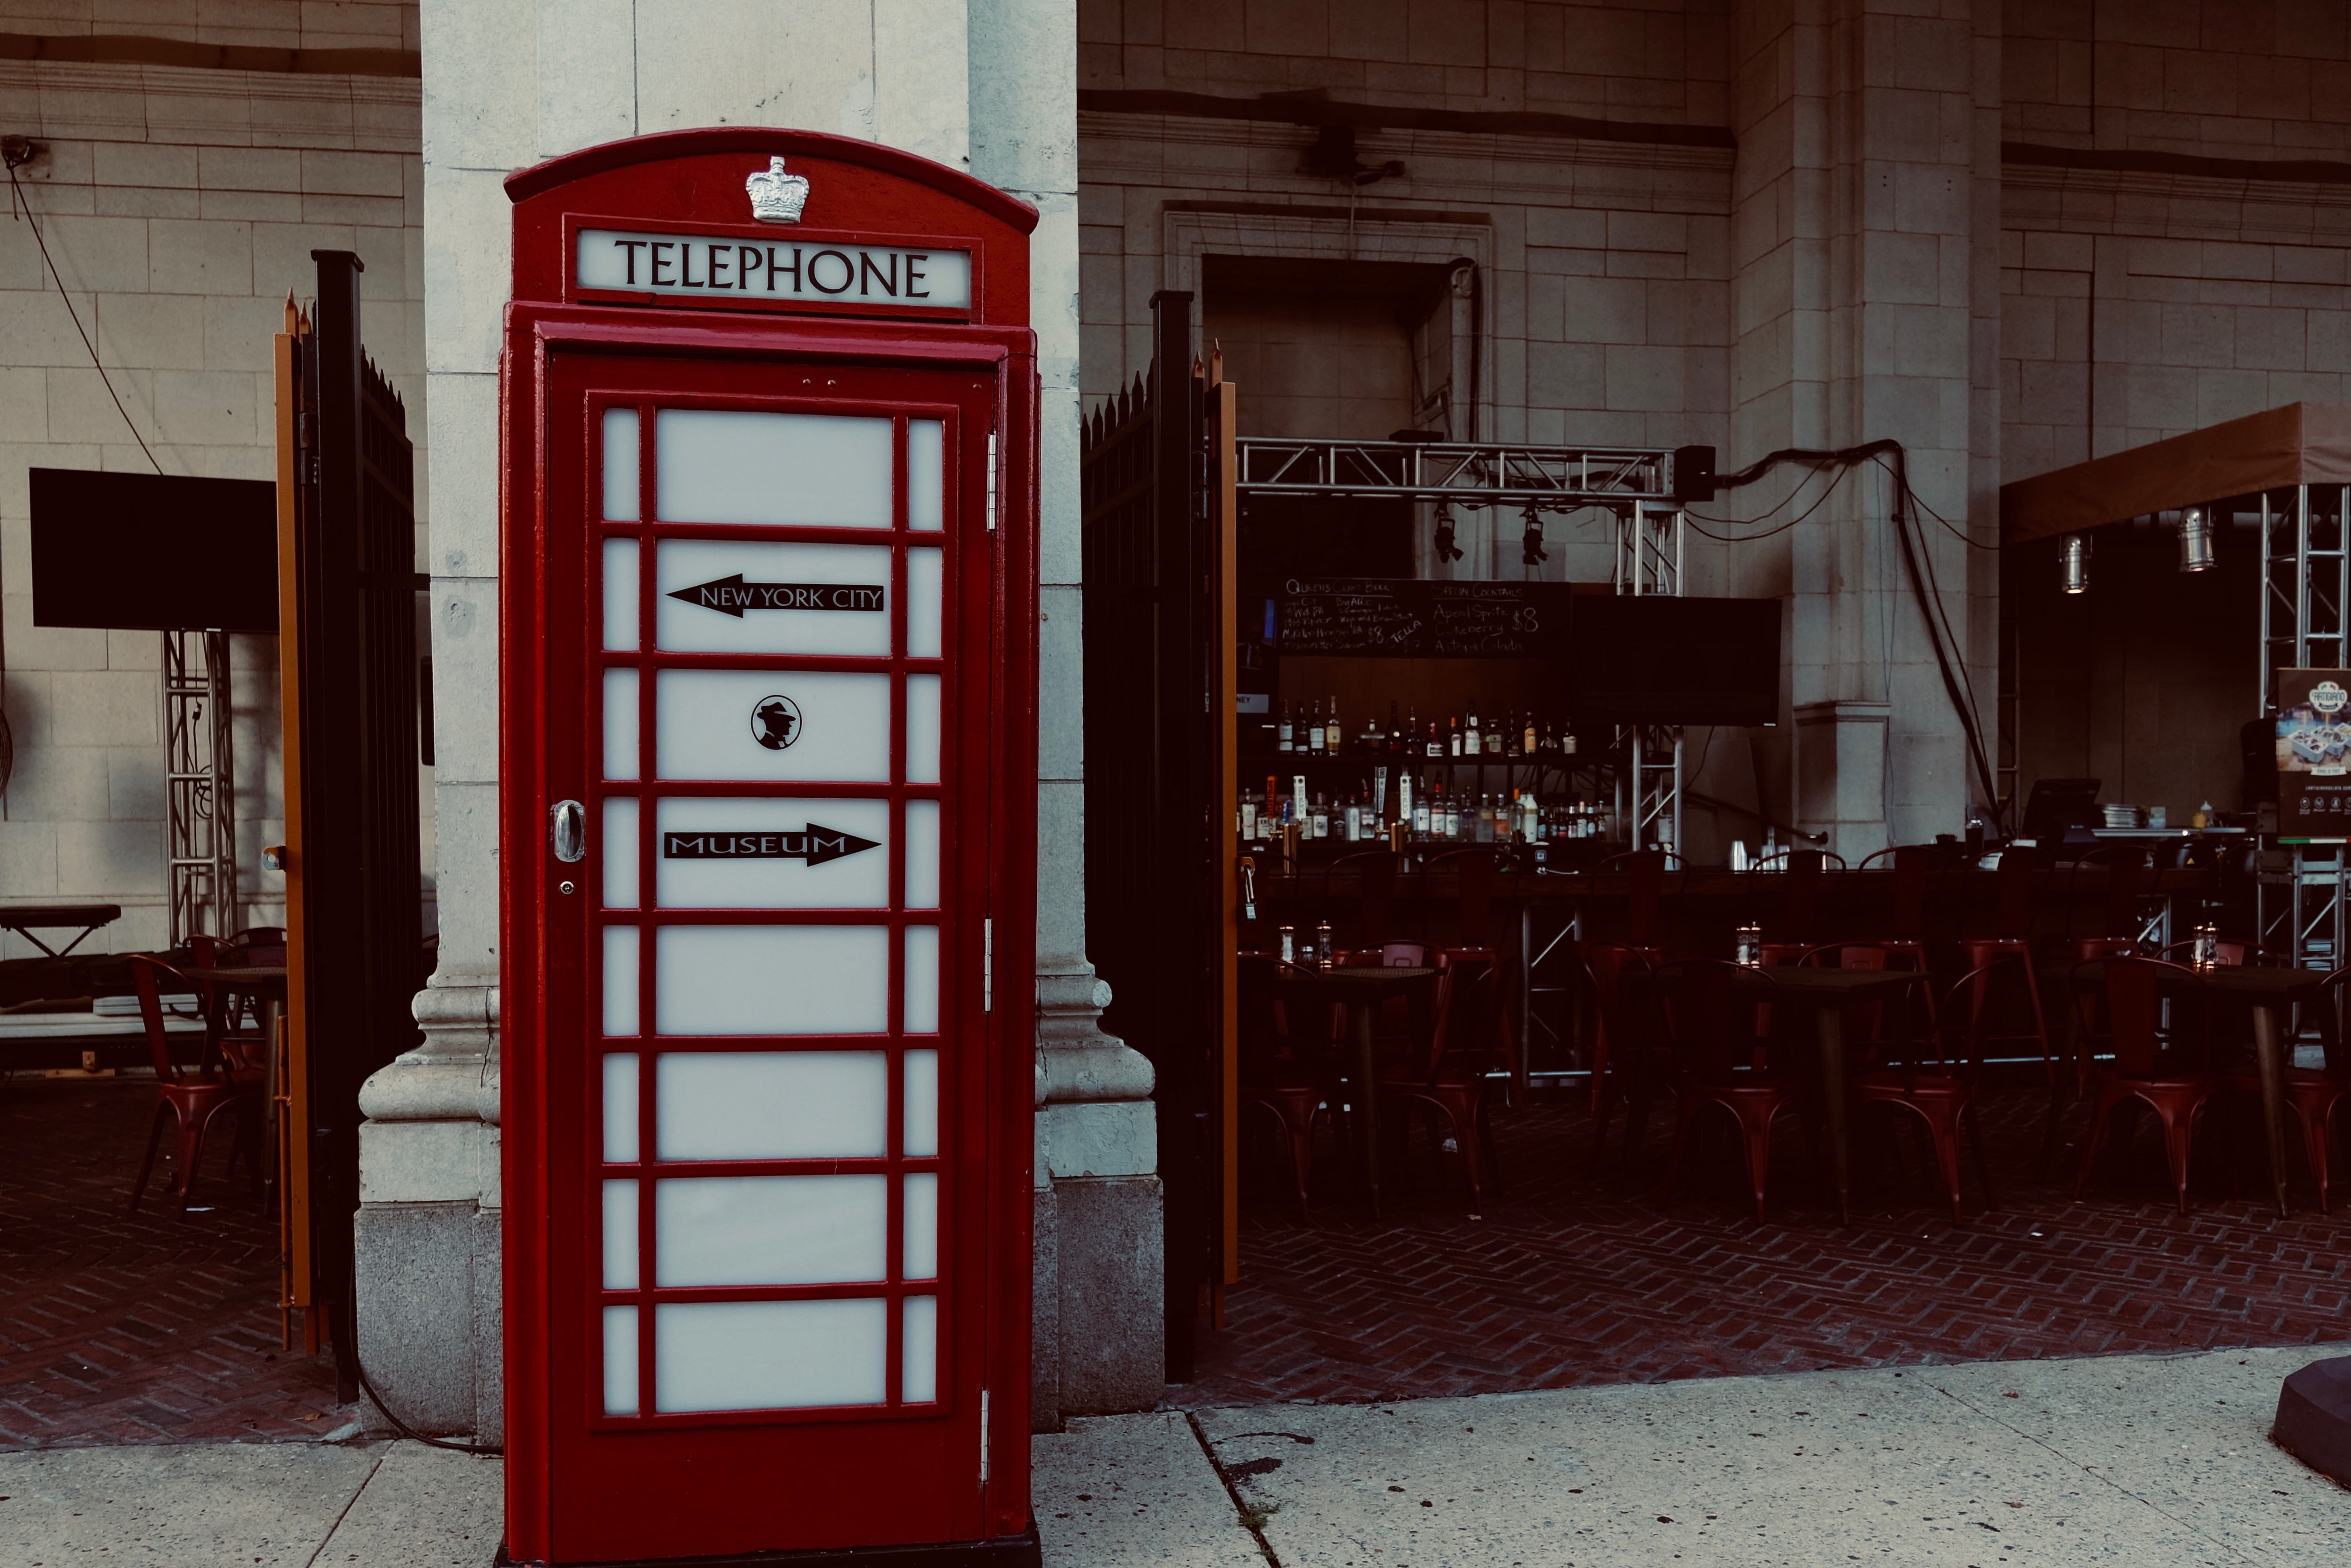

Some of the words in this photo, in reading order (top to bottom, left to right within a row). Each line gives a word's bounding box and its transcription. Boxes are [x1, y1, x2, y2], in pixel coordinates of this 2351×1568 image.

[614, 240, 930, 298] TELEPHONE
[701, 587, 753, 606] NEW
[760, 588, 824, 608] YORK
[832, 589, 882, 608] CITY
[671, 837, 845, 854] MUSEUM
